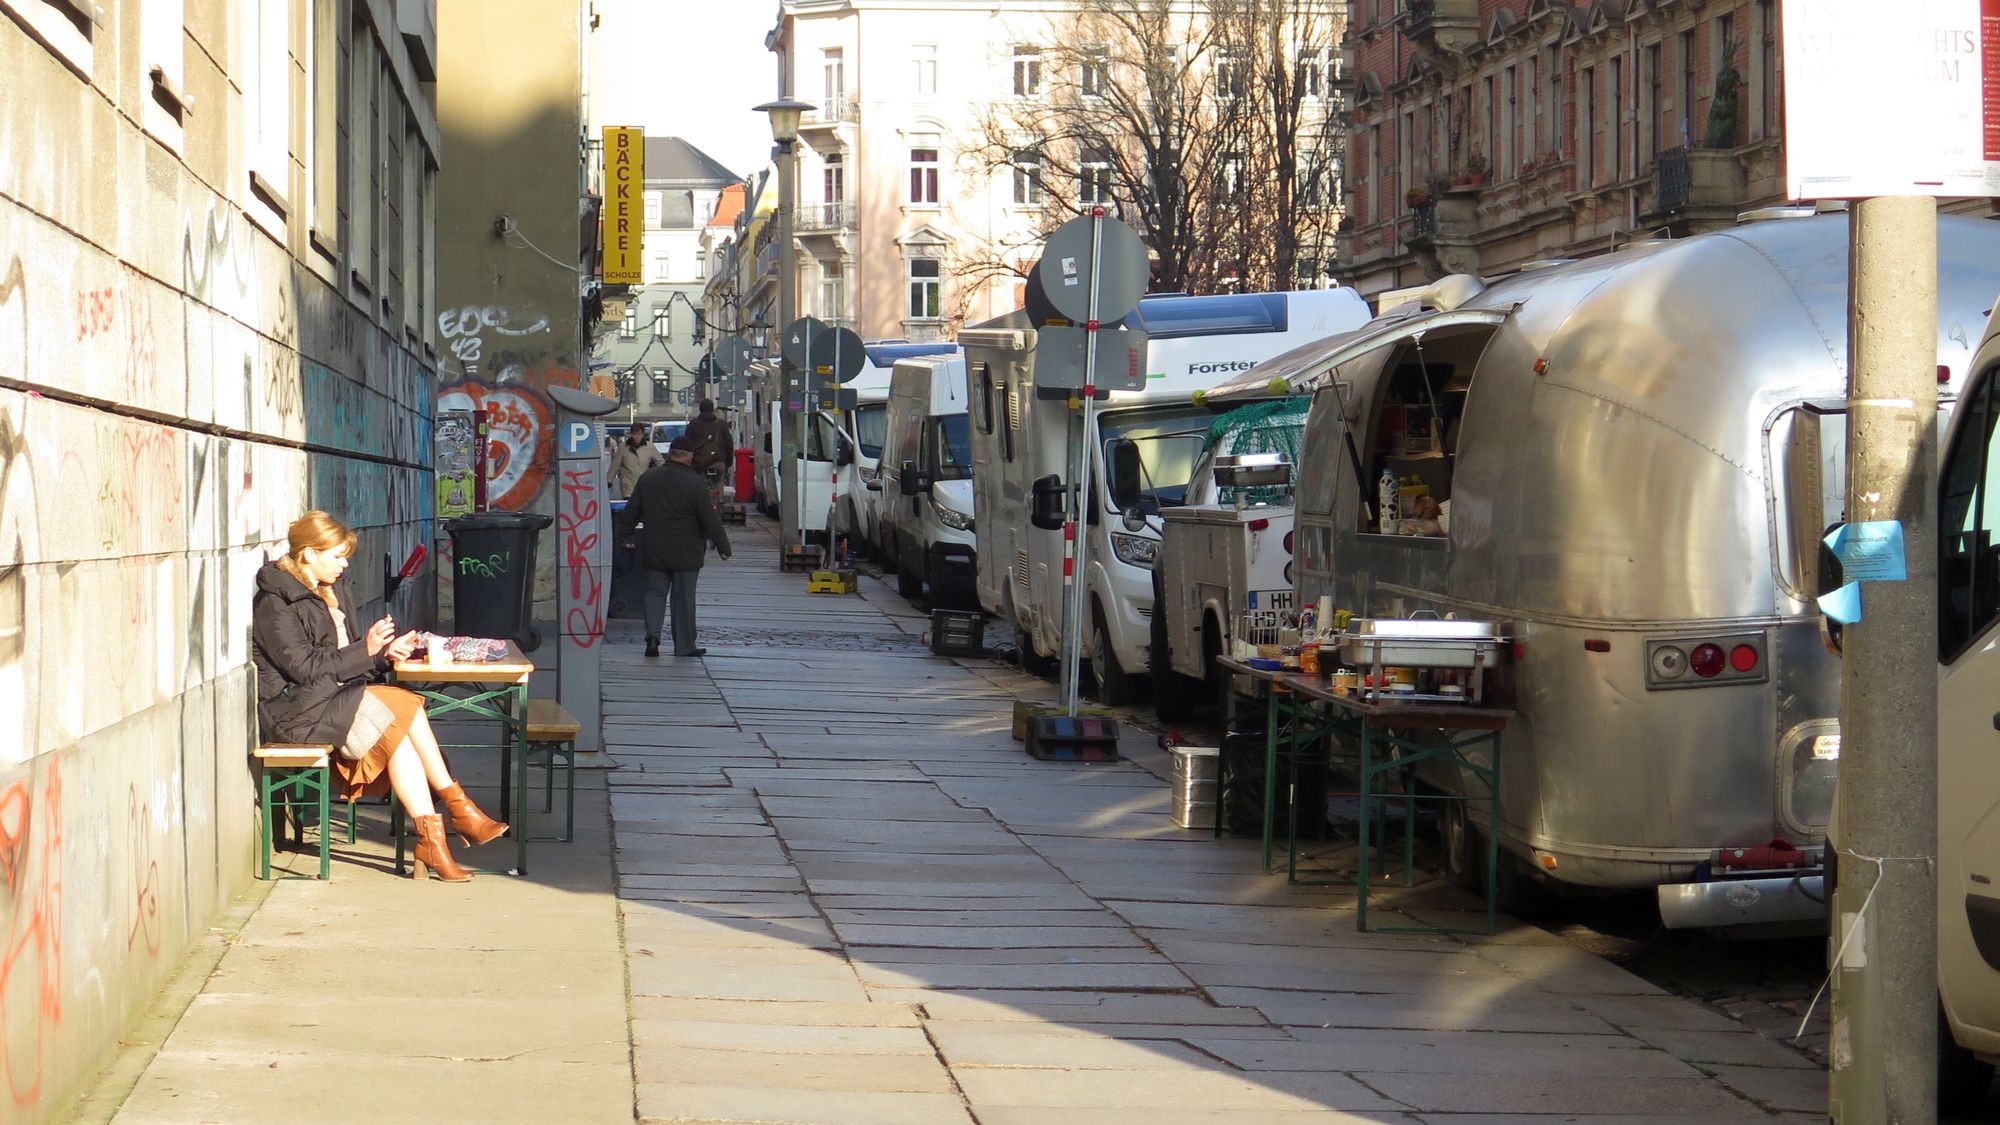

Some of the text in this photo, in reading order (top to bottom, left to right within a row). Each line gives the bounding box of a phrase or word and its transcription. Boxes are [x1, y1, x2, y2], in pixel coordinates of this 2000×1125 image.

[616, 133, 629, 268] BÄCKEREI
[1188, 360, 1258, 375] Forster
[569, 423, 591, 453] P
[1271, 592, 1293, 609] HH
